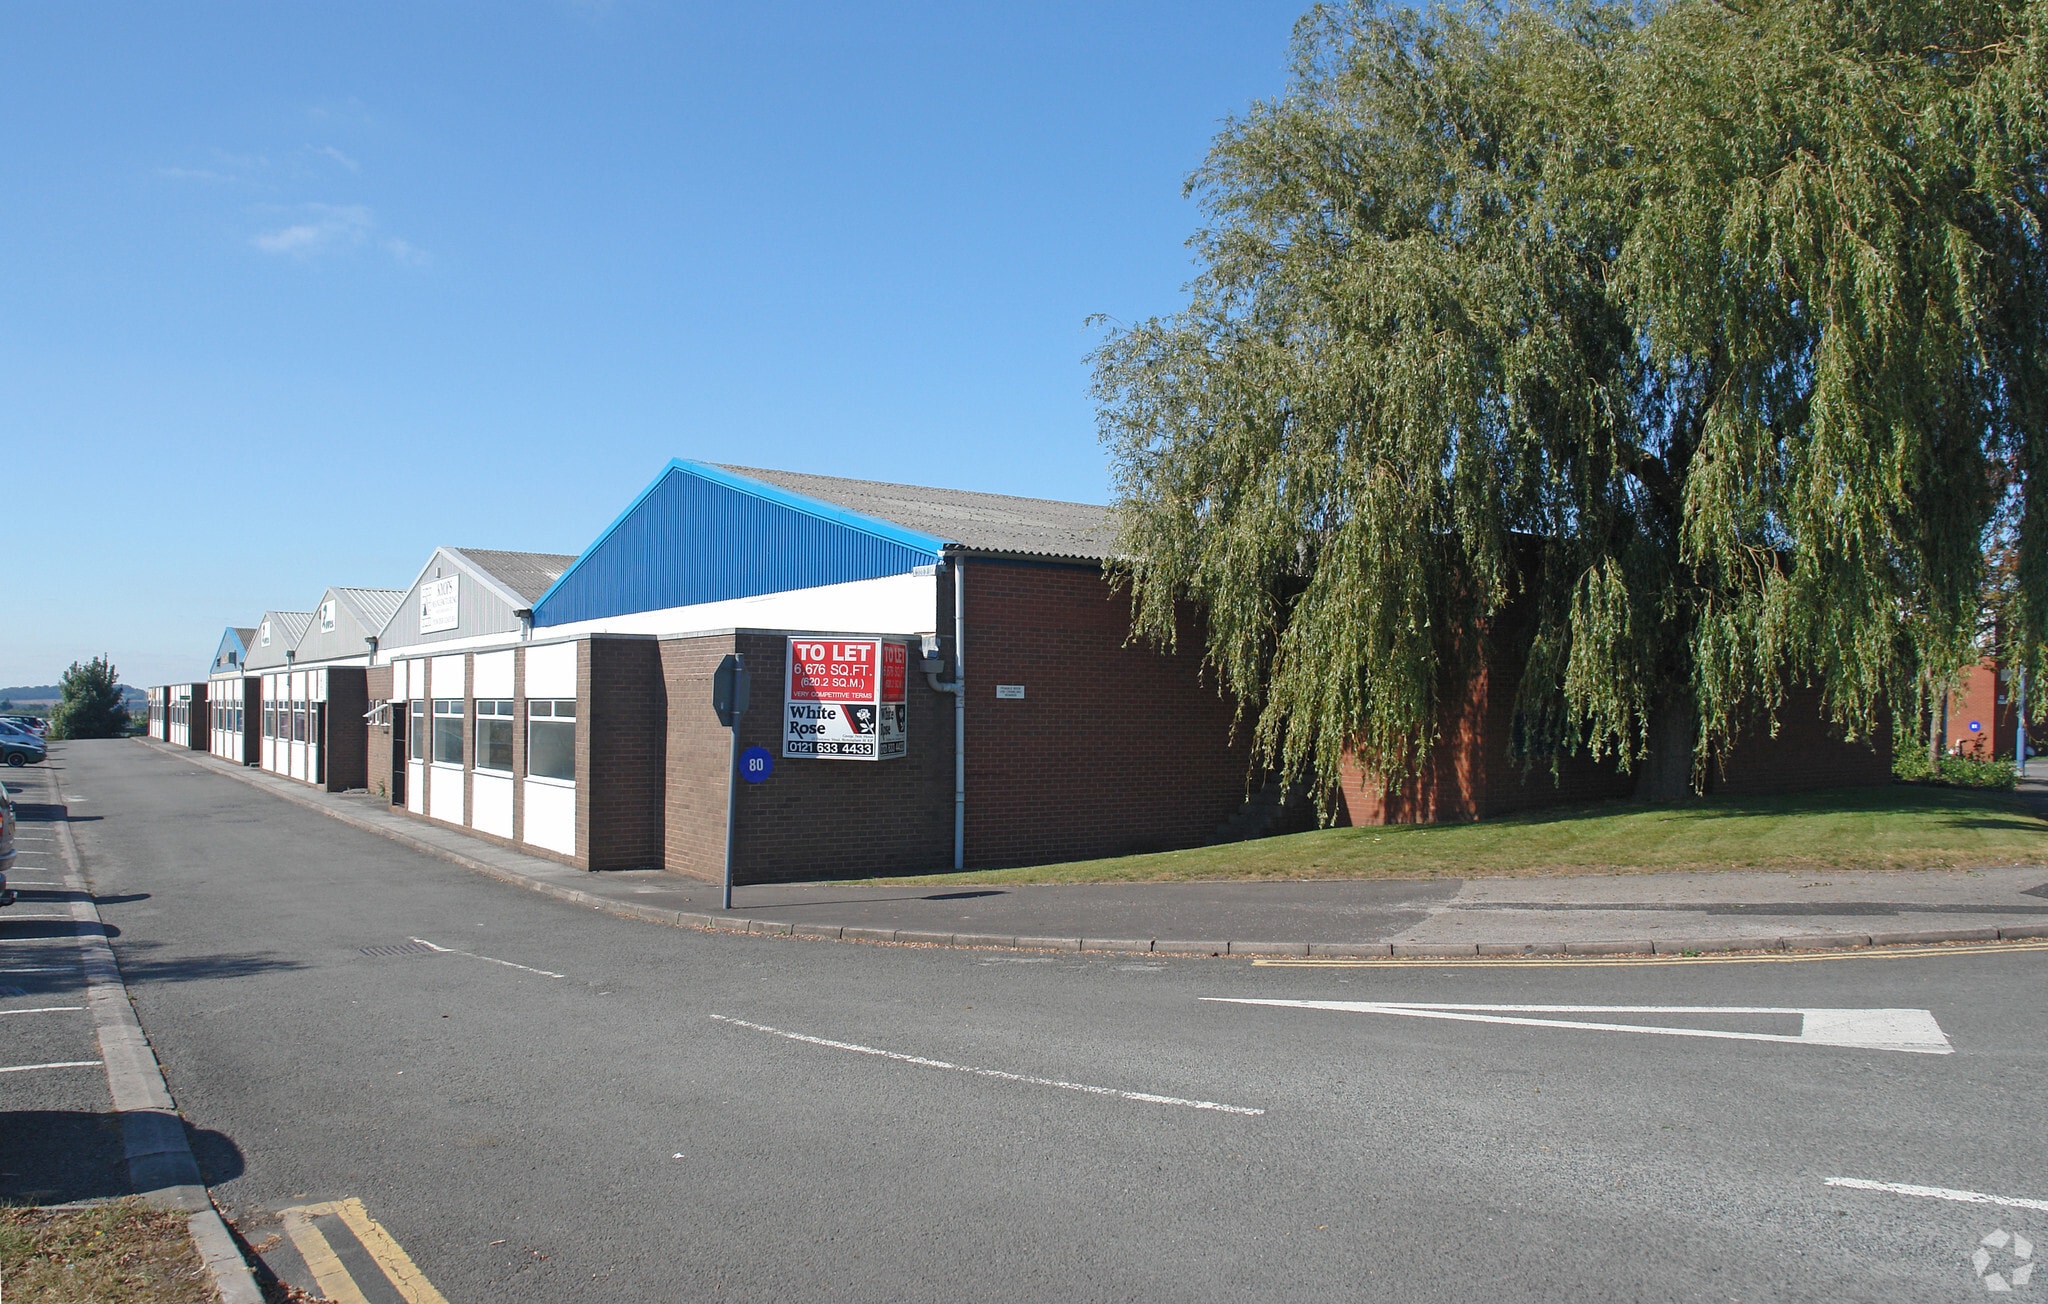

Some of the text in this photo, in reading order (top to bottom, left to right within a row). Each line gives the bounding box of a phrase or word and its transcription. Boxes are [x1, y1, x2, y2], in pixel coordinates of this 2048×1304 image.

[797, 644, 871, 662] TO LET
[884, 646, 894, 663] TO
[794, 663, 826, 676] 6,676
[830, 664, 873, 677] SQ.FT.
[800, 677, 865, 690] (620.2 SQ.M.)
[790, 705, 836, 720] White
[789, 721, 826, 740] Rose
[789, 742, 813, 752] 0121
[816, 743, 838, 753] 633
[842, 744, 872, 754] 4433
[749, 758, 764, 771] 80
